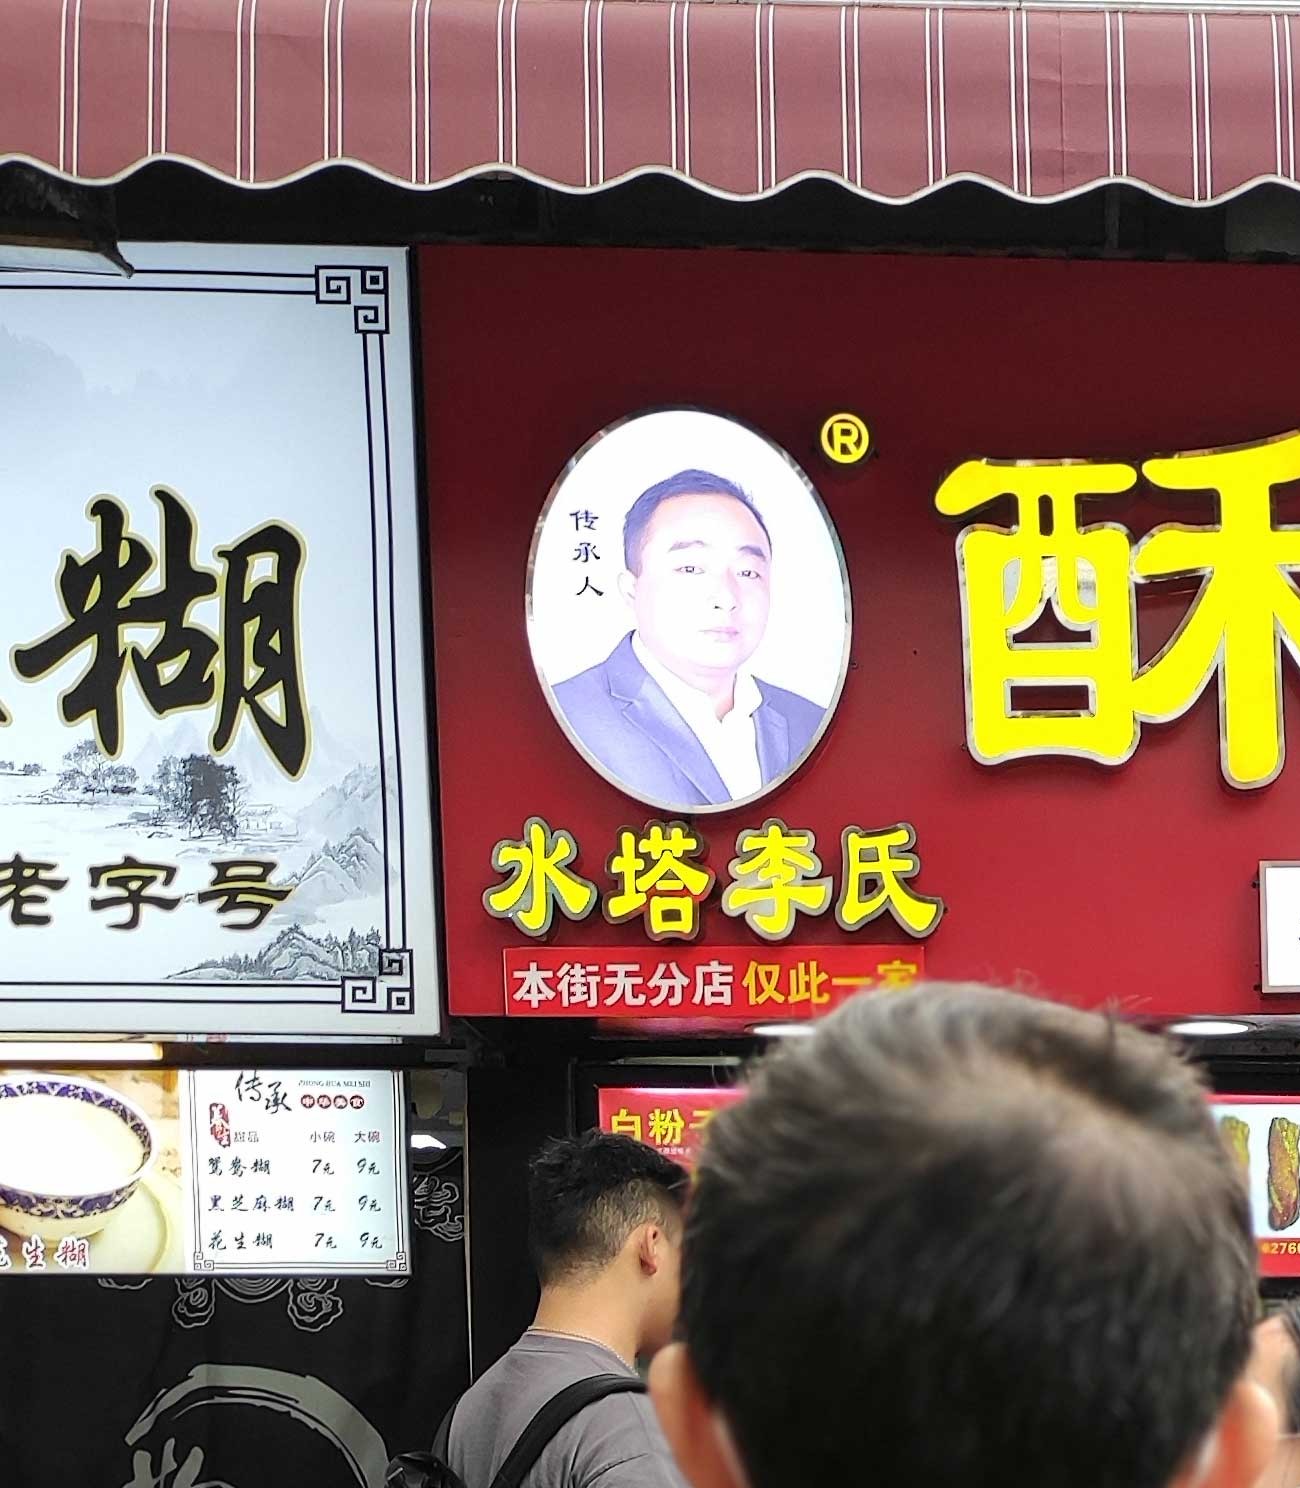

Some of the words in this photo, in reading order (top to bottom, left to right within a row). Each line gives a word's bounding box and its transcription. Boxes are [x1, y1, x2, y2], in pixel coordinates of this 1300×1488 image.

[569, 509, 604, 597] 传承人
[0, 485, 308, 780] 糊
[0, 853, 295, 931] 老字号
[482, 817, 943, 941] 水塔李氏
[512, 962, 734, 1008] 本街无分店
[311, 1158, 335, 1176] 7元
[356, 1157, 380, 1176] 9元
[208, 1194, 294, 1213] 黑芝麻糊
[312, 1195, 336, 1213] 7元
[358, 1194, 382, 1212] 9元
[208, 1230, 273, 1250] 花生糊
[314, 1232, 337, 1250] 7元
[359, 1231, 383, 1249] 9元
